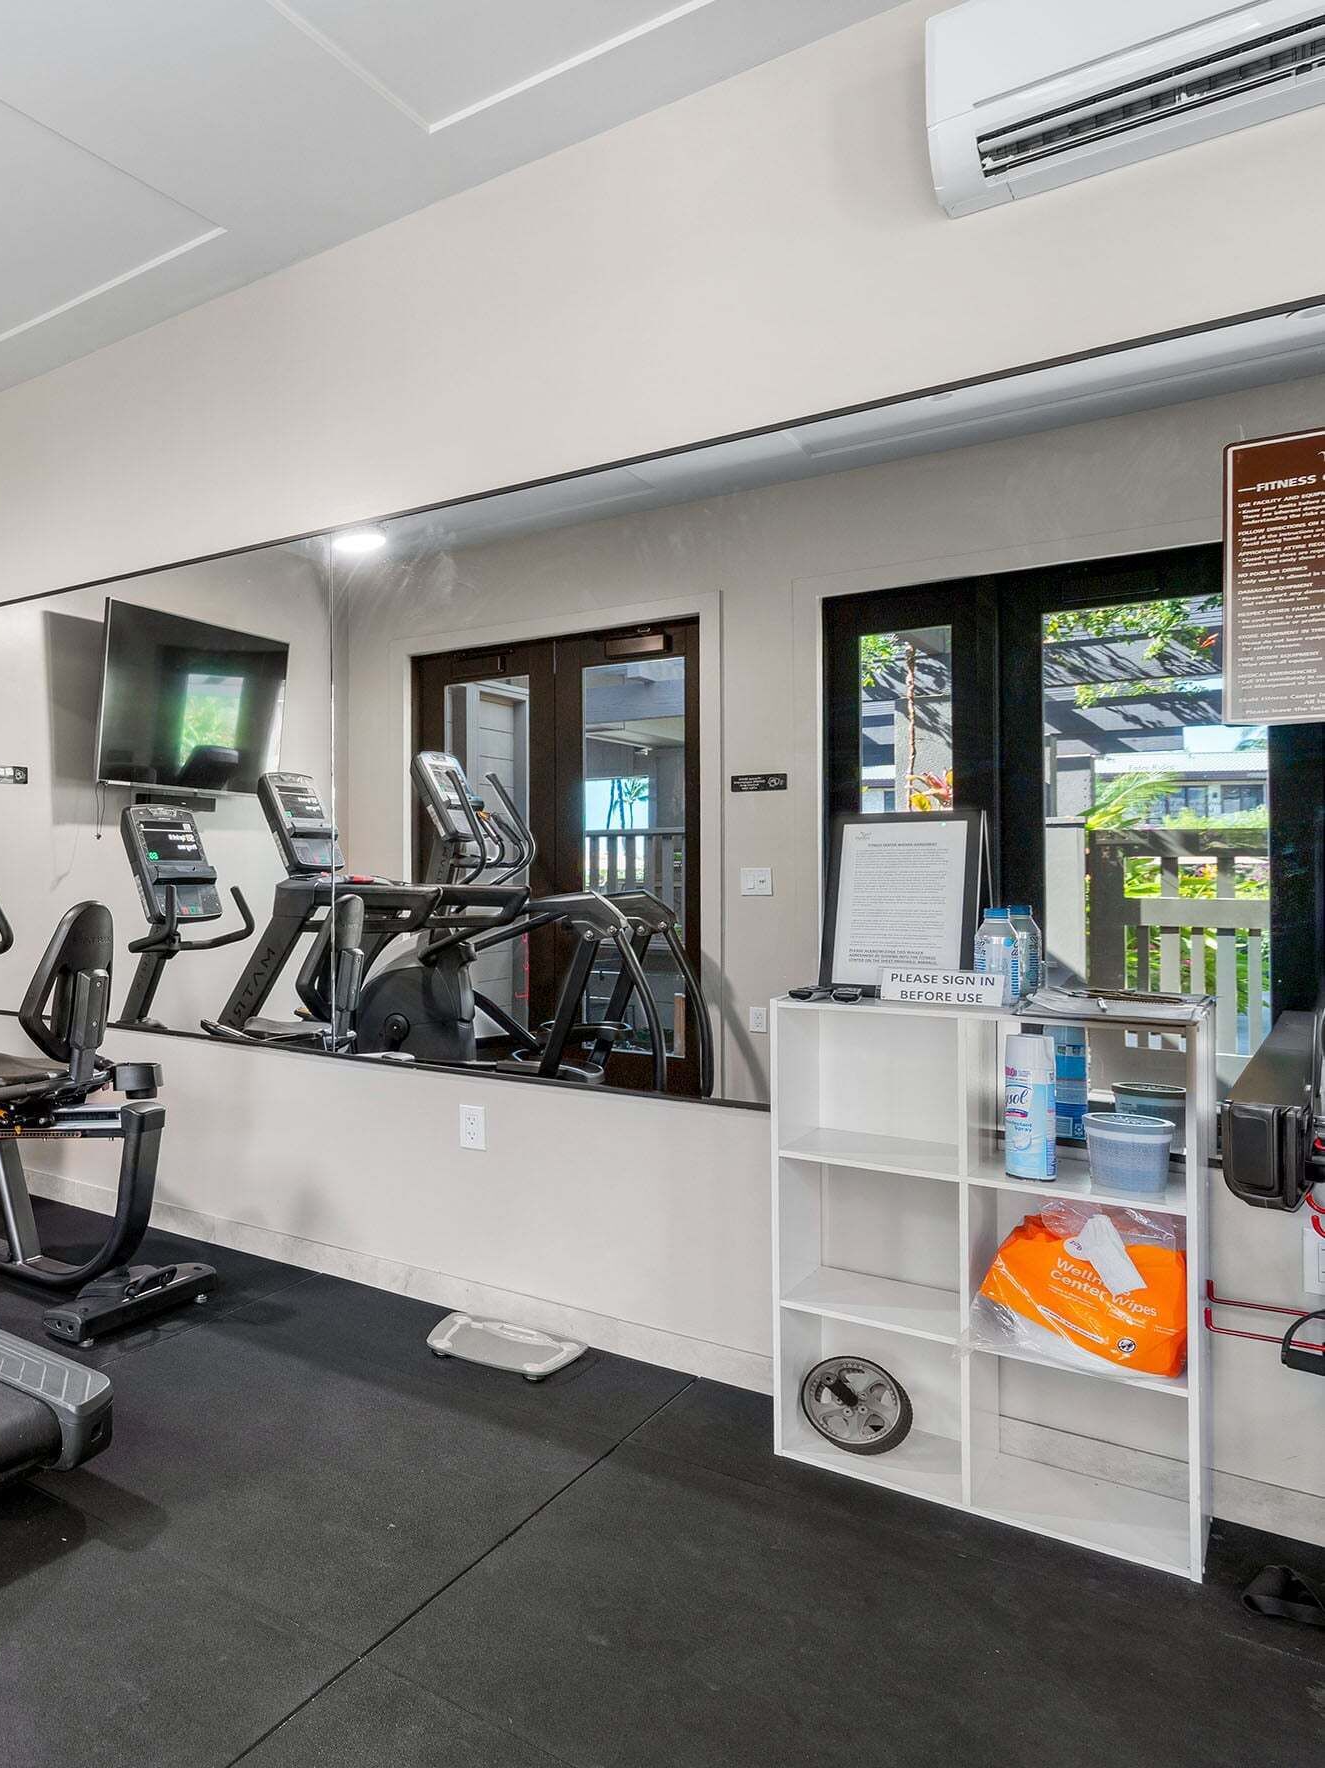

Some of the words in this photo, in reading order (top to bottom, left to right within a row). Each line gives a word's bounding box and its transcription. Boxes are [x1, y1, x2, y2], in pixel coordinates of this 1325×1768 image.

[1257, 475, 1316, 493] FITNESS
[1253, 497, 1282, 506] FACILITY
[1301, 491, 1325, 499] EQUIPM
[1267, 523, 1306, 532] DIRECTIONS
[1238, 547, 1281, 557] APPROPRIATE
[890, 972, 938, 984] PLEASE
[943, 975, 976, 986] SIGN
[980, 976, 995, 986] IN
[900, 990, 952, 1002] BEFORE
[957, 992, 983, 1003] USE
[1050, 1269, 1108, 1303] Center
[1112, 1294, 1157, 1317] Wipes
